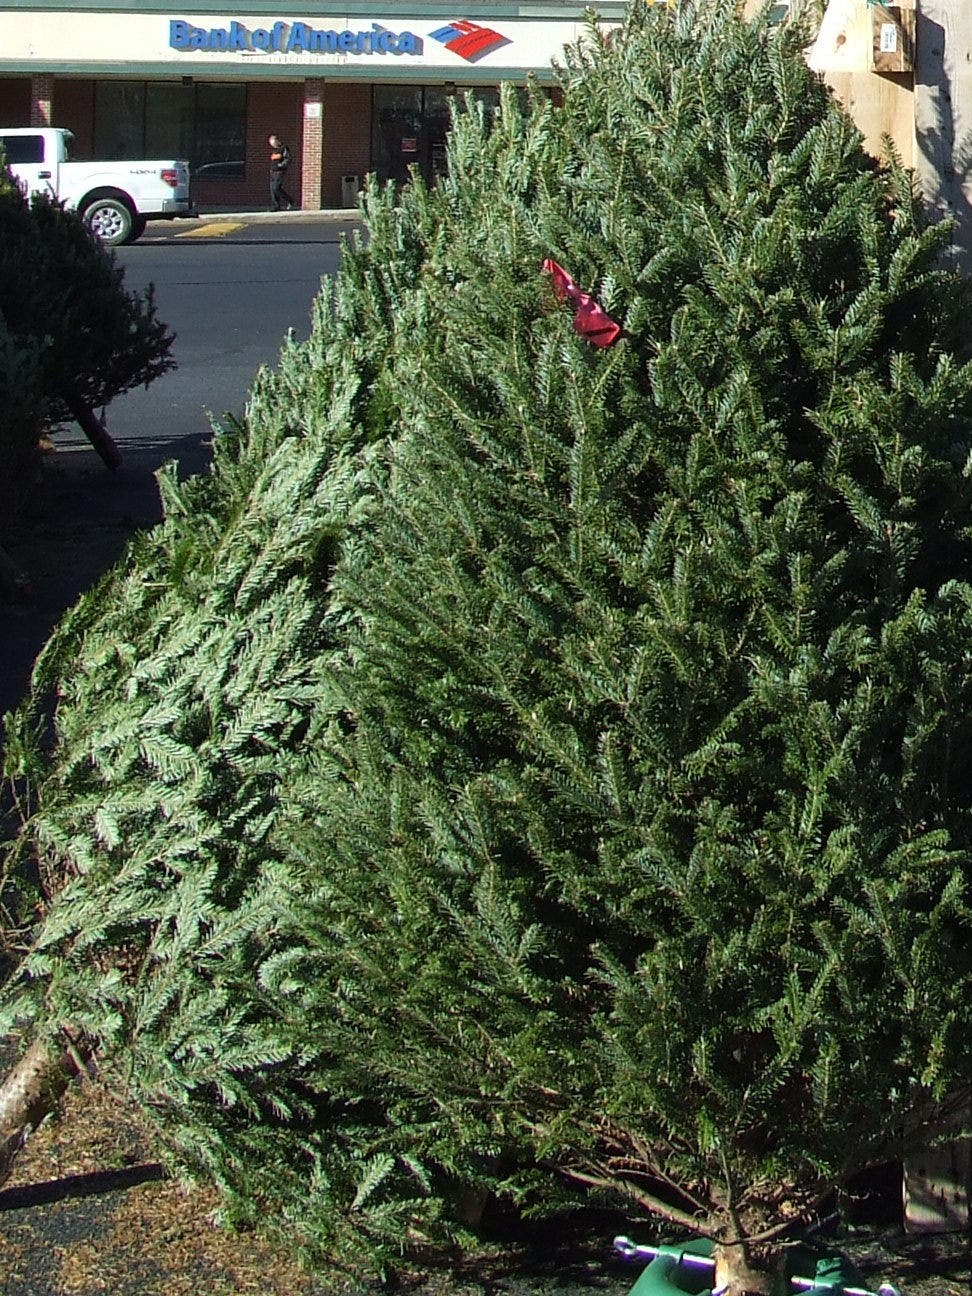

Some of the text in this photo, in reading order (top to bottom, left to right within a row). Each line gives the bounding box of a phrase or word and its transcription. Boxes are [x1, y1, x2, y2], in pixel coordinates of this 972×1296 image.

[169, 19, 420, 55] Bank of America
